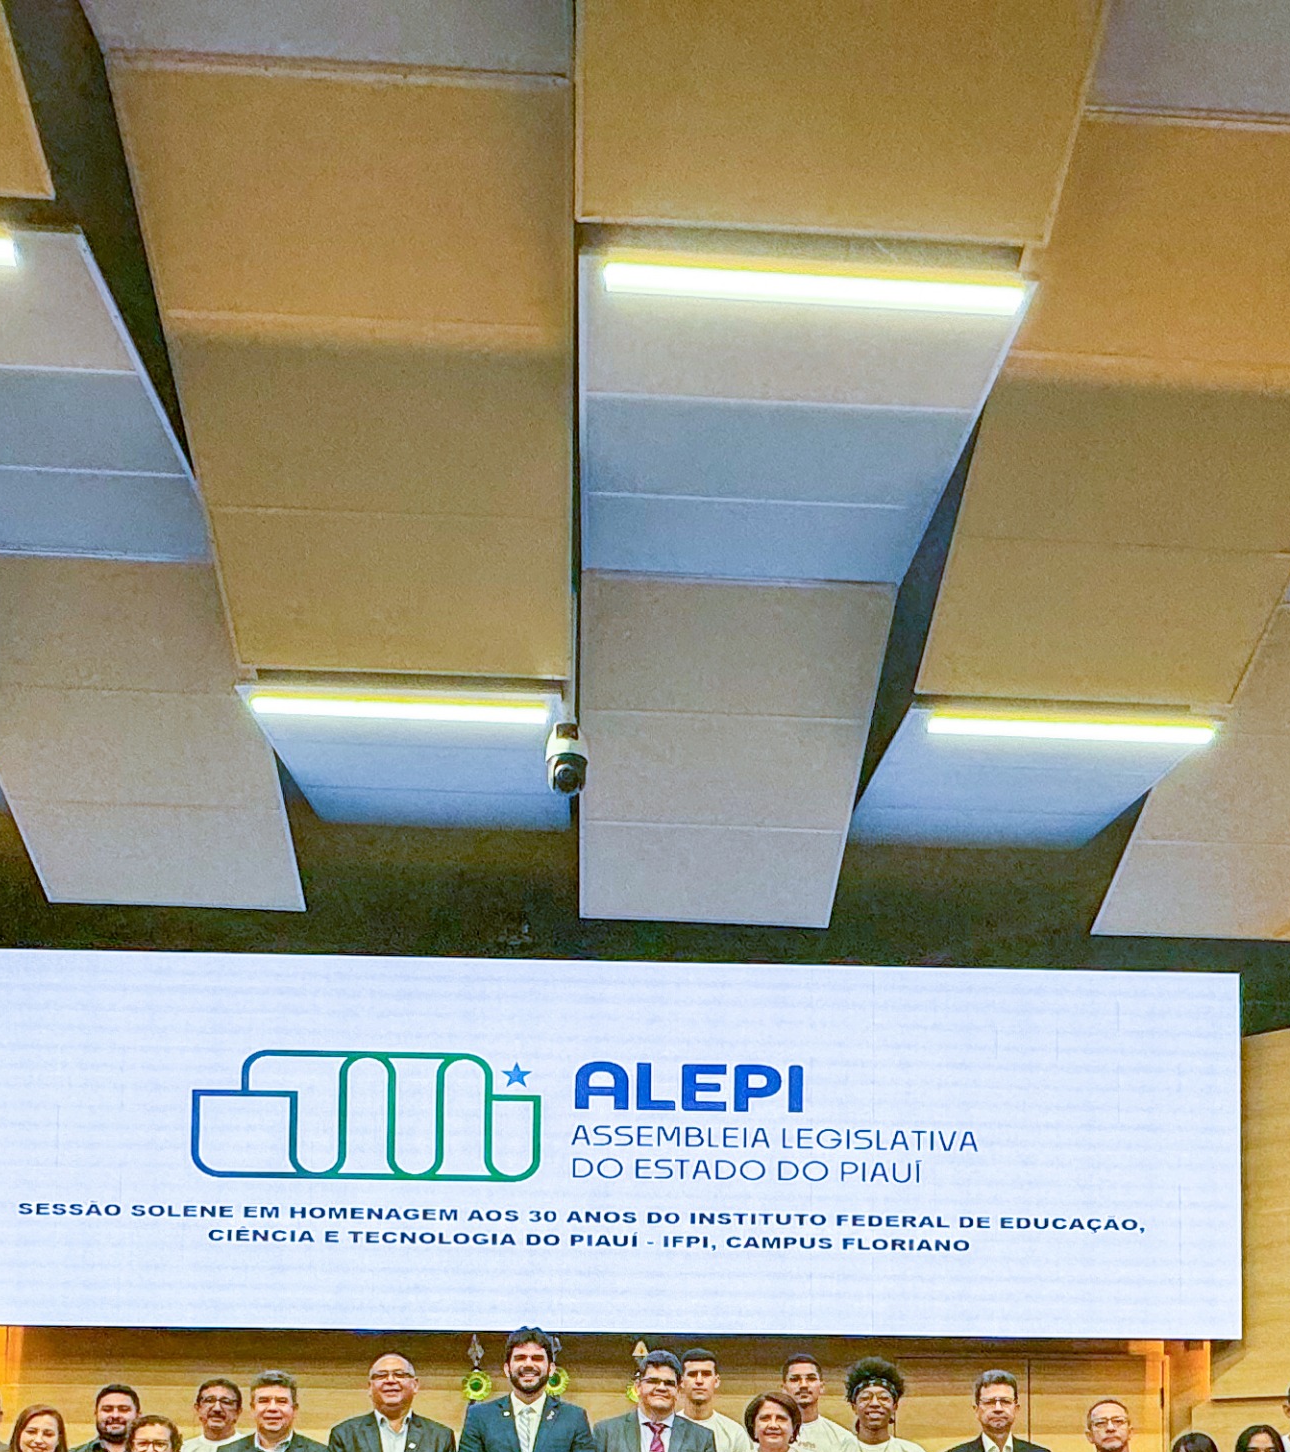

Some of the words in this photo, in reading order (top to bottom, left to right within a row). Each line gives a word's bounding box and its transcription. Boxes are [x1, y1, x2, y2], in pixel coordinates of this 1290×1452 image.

[574, 1060, 804, 1114] ALEPI
[571, 1124, 770, 1149] ASSEMBLEIA
[782, 1127, 978, 1153] LEGISLATIVA
[572, 1157, 624, 1179] DO
[634, 1158, 766, 1181] ESTADO
[777, 1160, 829, 1182] DO
[840, 1158, 923, 1184] PIAUÍ
[18, 1200, 122, 1217] SESSÃO
[130, 1204, 234, 1219] SOLENE
[243, 1206, 280, 1219] EM
[289, 1206, 458, 1222] HOMENAGEM
[467, 1209, 519, 1223] AOS
[529, 1210, 557, 1223] 30
[566, 1210, 637, 1224] ANOS
[646, 1211, 680, 1225] DO
[690, 1212, 827, 1227] INSTITUTO
[836, 1214, 950, 1229] FEDERAL
[959, 1216, 991, 1229] DE
[1000, 1215, 1146, 1234] EDUCAÇÃO,
[208, 1226, 315, 1243] CIÊNCIA
[324, 1230, 340, 1244] E
[347, 1230, 517, 1246] TECNOLOGIA
[526, 1233, 561, 1247] DO
[570, 1232, 638, 1248] PIAUÍ
[663, 1235, 717, 1252] IFPI,
[726, 1236, 833, 1250] CAMPUS
[842, 1237, 970, 1252] FLORIANO
